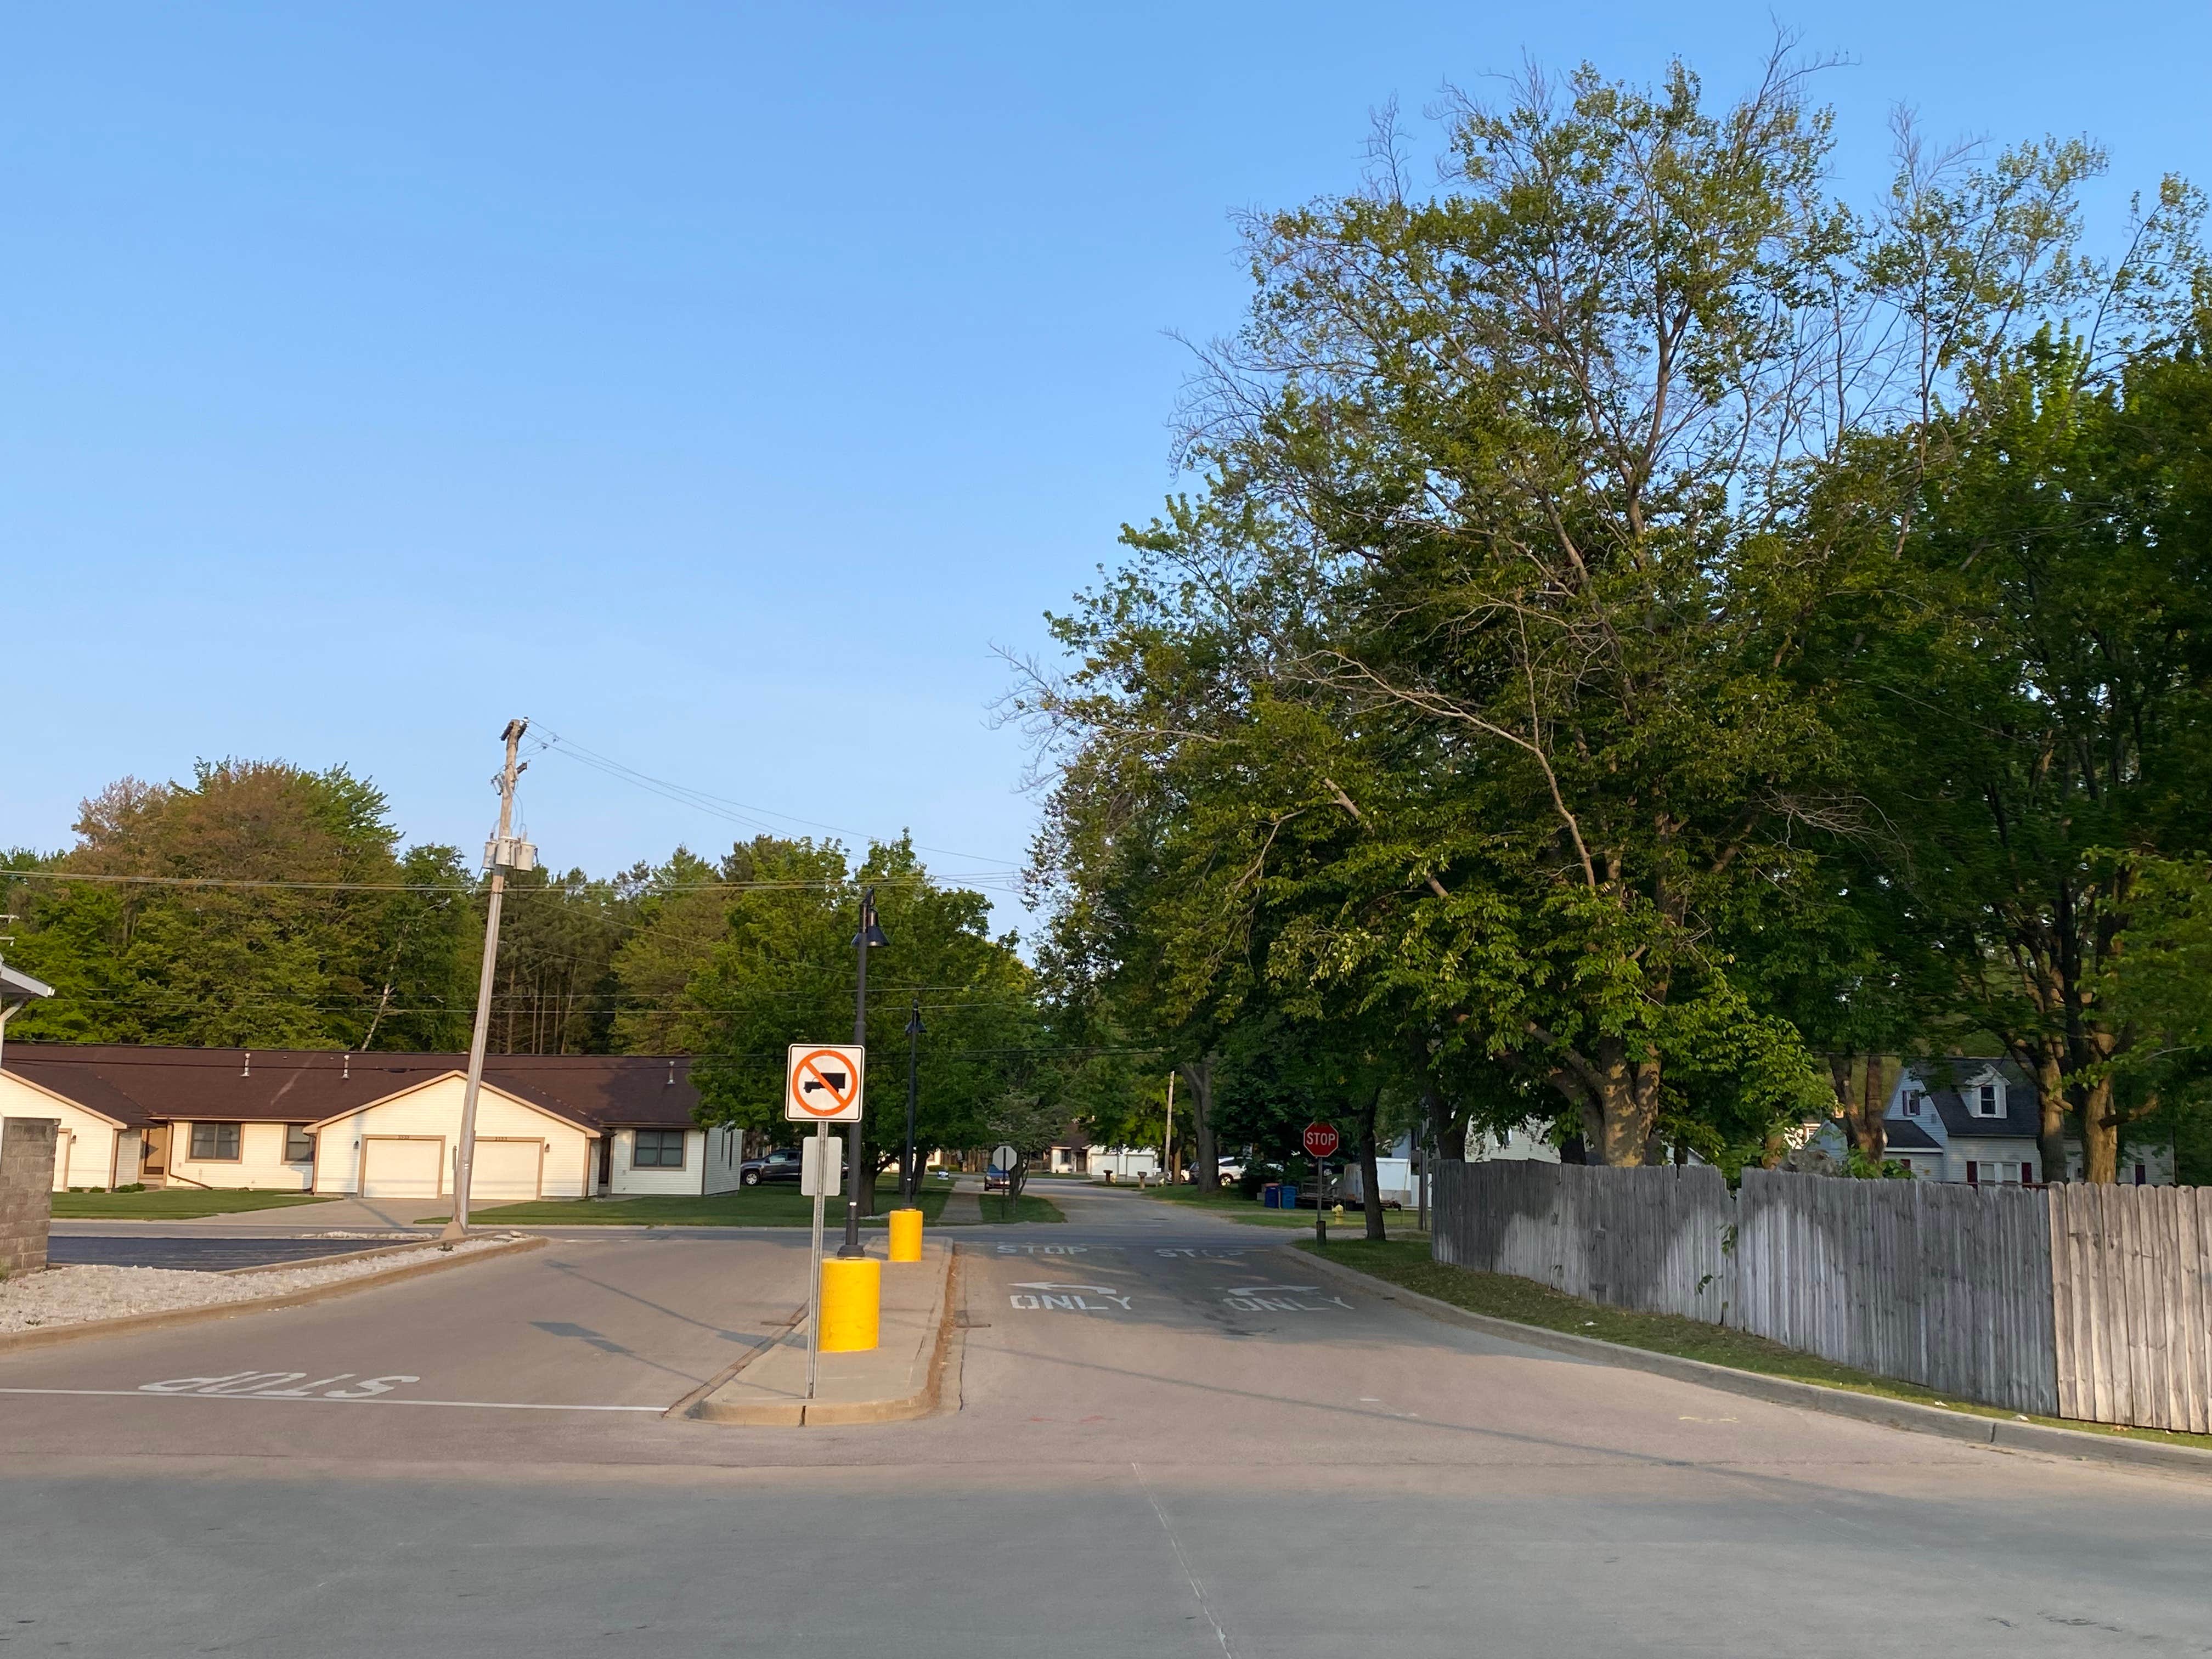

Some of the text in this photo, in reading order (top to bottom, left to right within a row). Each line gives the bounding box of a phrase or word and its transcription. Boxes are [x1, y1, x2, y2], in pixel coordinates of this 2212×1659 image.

[1306, 1132, 1336, 1146] STOP
[996, 1244, 1088, 1255] STOP
[1009, 1295, 1132, 1310] ONLY
[1222, 1296, 1356, 1312] ONLY
[138, 1371, 421, 1398] STOP
